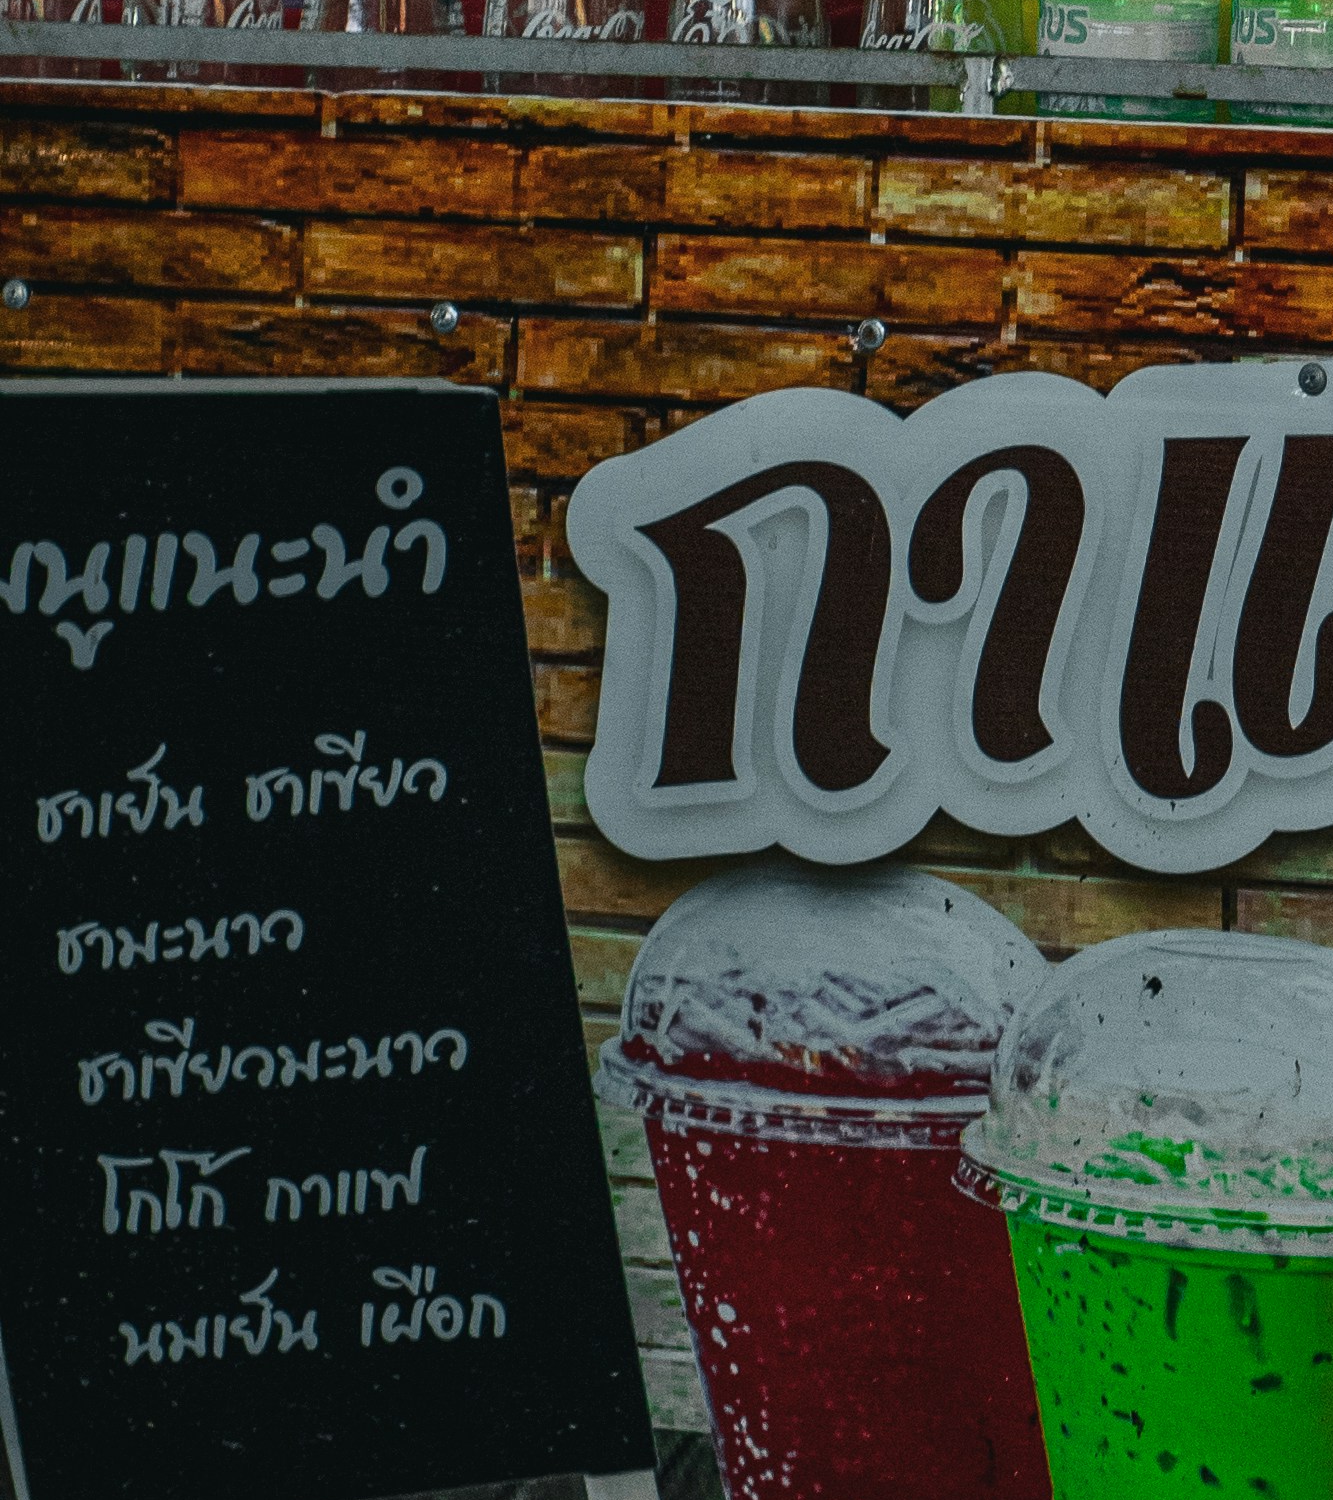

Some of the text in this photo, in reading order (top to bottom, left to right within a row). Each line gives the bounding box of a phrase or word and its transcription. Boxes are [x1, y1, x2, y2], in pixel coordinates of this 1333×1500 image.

[0, 465, 448, 670] นูแนะนำ
[35, 729, 450, 844] ชาเย็น ชาเขียว
[55, 904, 306, 976] ชามะนาว
[77, 1017, 470, 1107] ชาเขียวมะนาว
[97, 1145, 428, 1236] โกโก้ กาแฟ
[118, 1263, 508, 1368] นมเย็น เผือก
